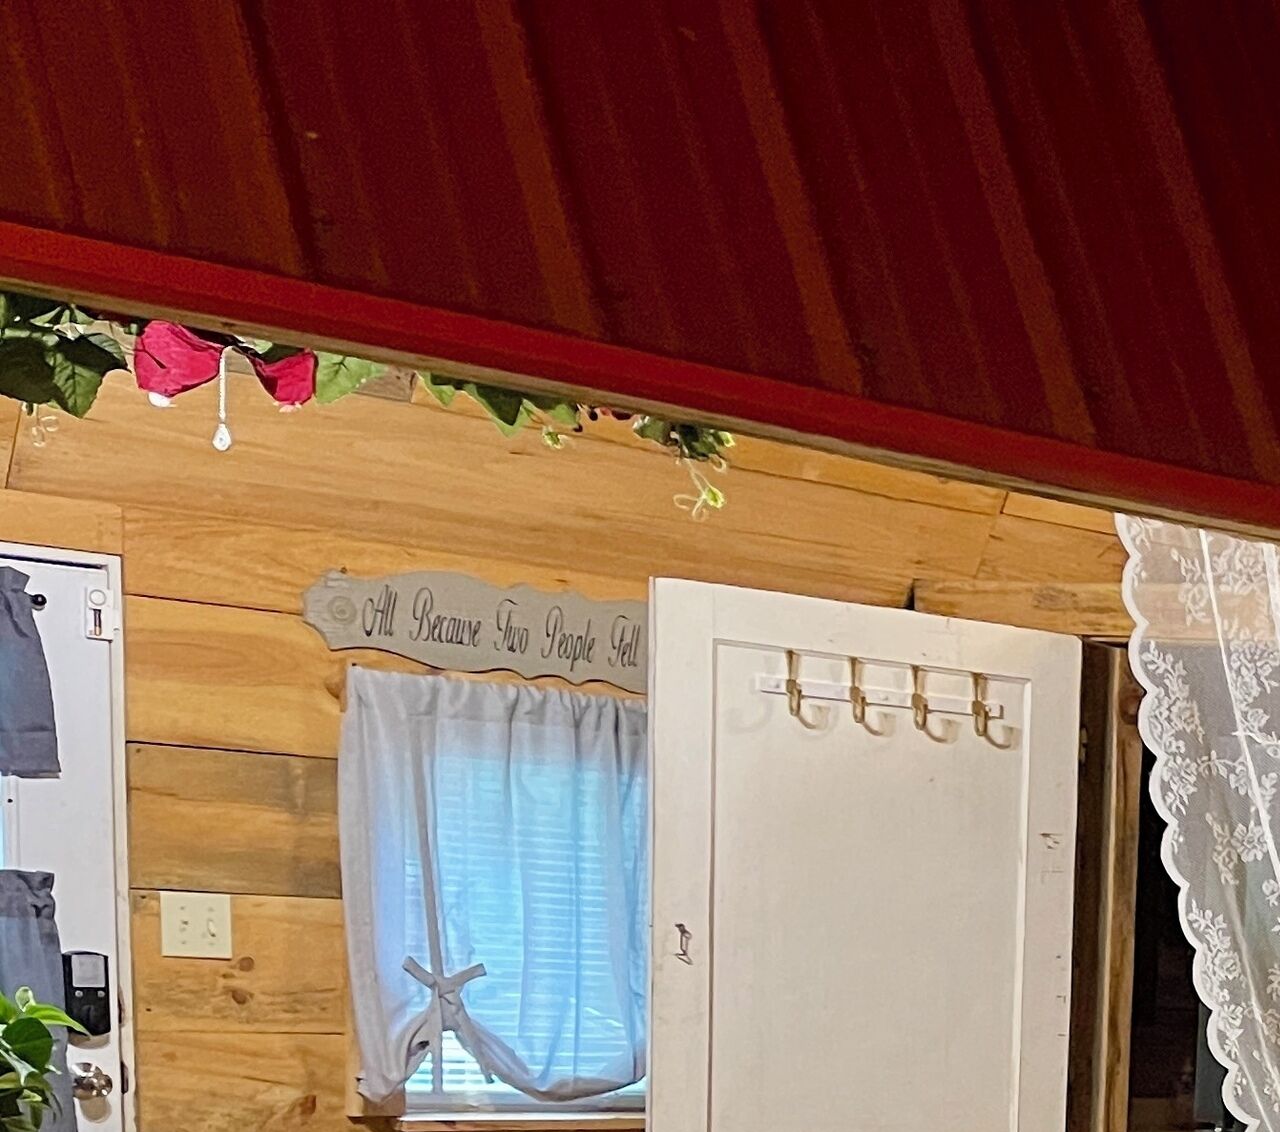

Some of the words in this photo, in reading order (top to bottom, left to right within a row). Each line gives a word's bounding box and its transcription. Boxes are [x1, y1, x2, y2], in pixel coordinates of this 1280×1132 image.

[362, 584, 398, 637] All
[409, 587, 481, 647] Because
[494, 598, 529, 655] Two
[541, 605, 596, 672] People
[608, 614, 641, 668] Fell
